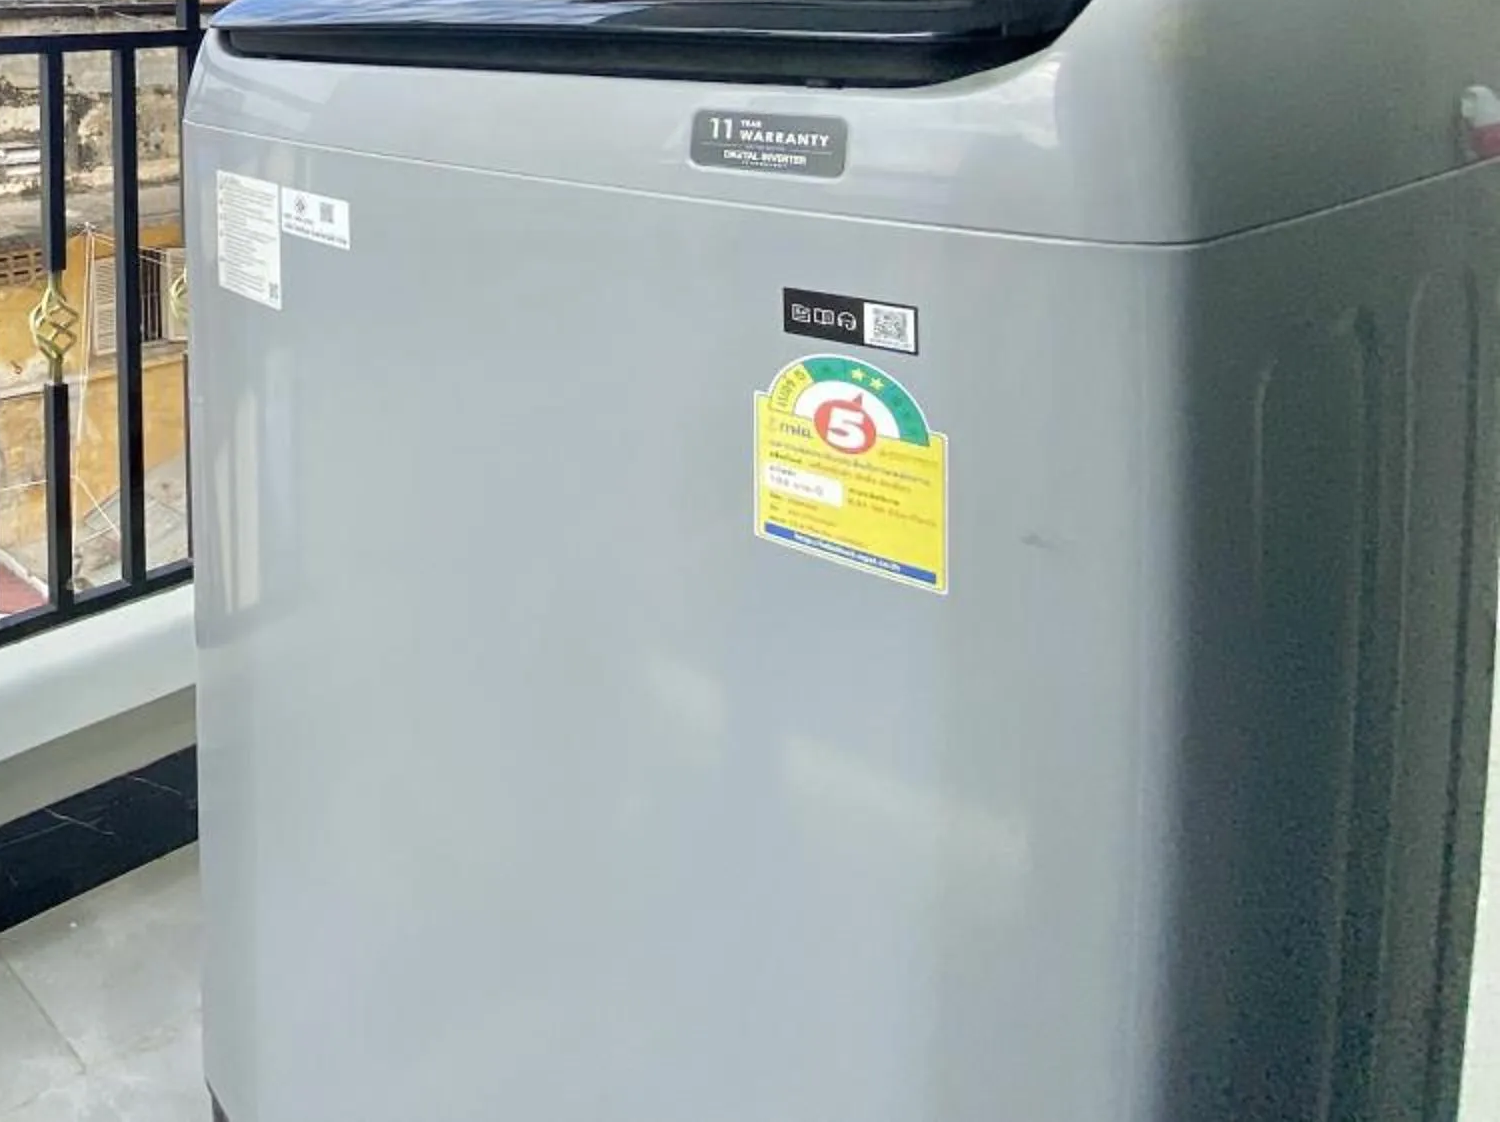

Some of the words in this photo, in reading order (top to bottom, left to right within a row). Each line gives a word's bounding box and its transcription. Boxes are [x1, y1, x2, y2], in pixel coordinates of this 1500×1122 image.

[708, 117, 733, 140] 11
[739, 129, 830, 147] WARRANTY
[826, 403, 866, 450] 5
